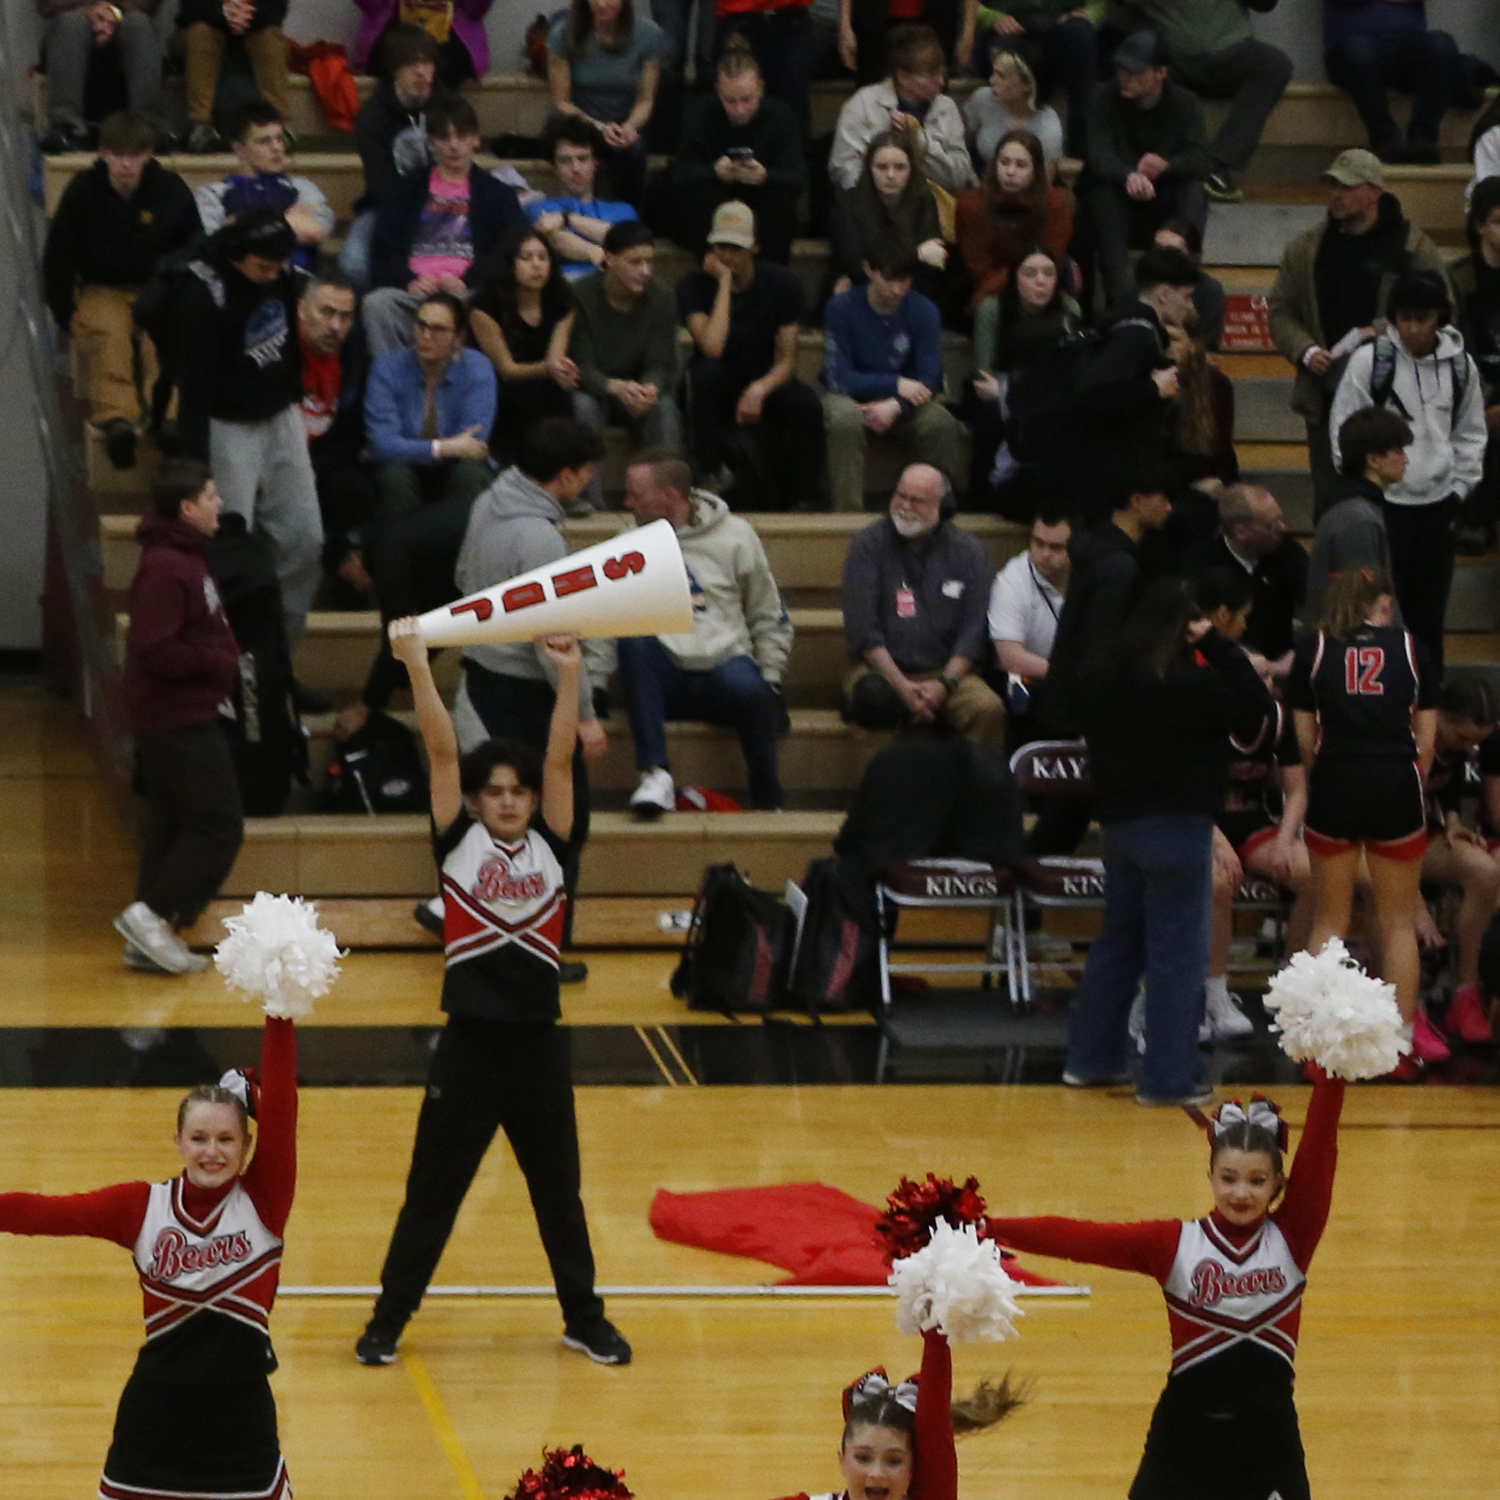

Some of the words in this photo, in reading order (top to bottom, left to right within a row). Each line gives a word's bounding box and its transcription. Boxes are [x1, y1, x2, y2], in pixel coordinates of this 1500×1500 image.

[450, 550, 646, 622] JDHS
[1344, 646, 1385, 695] 12
[1032, 756, 1086, 779] KAY
[925, 876, 999, 896] KINGS
[148, 1227, 252, 1280] Bears
[1188, 1258, 1287, 1308] Bears
